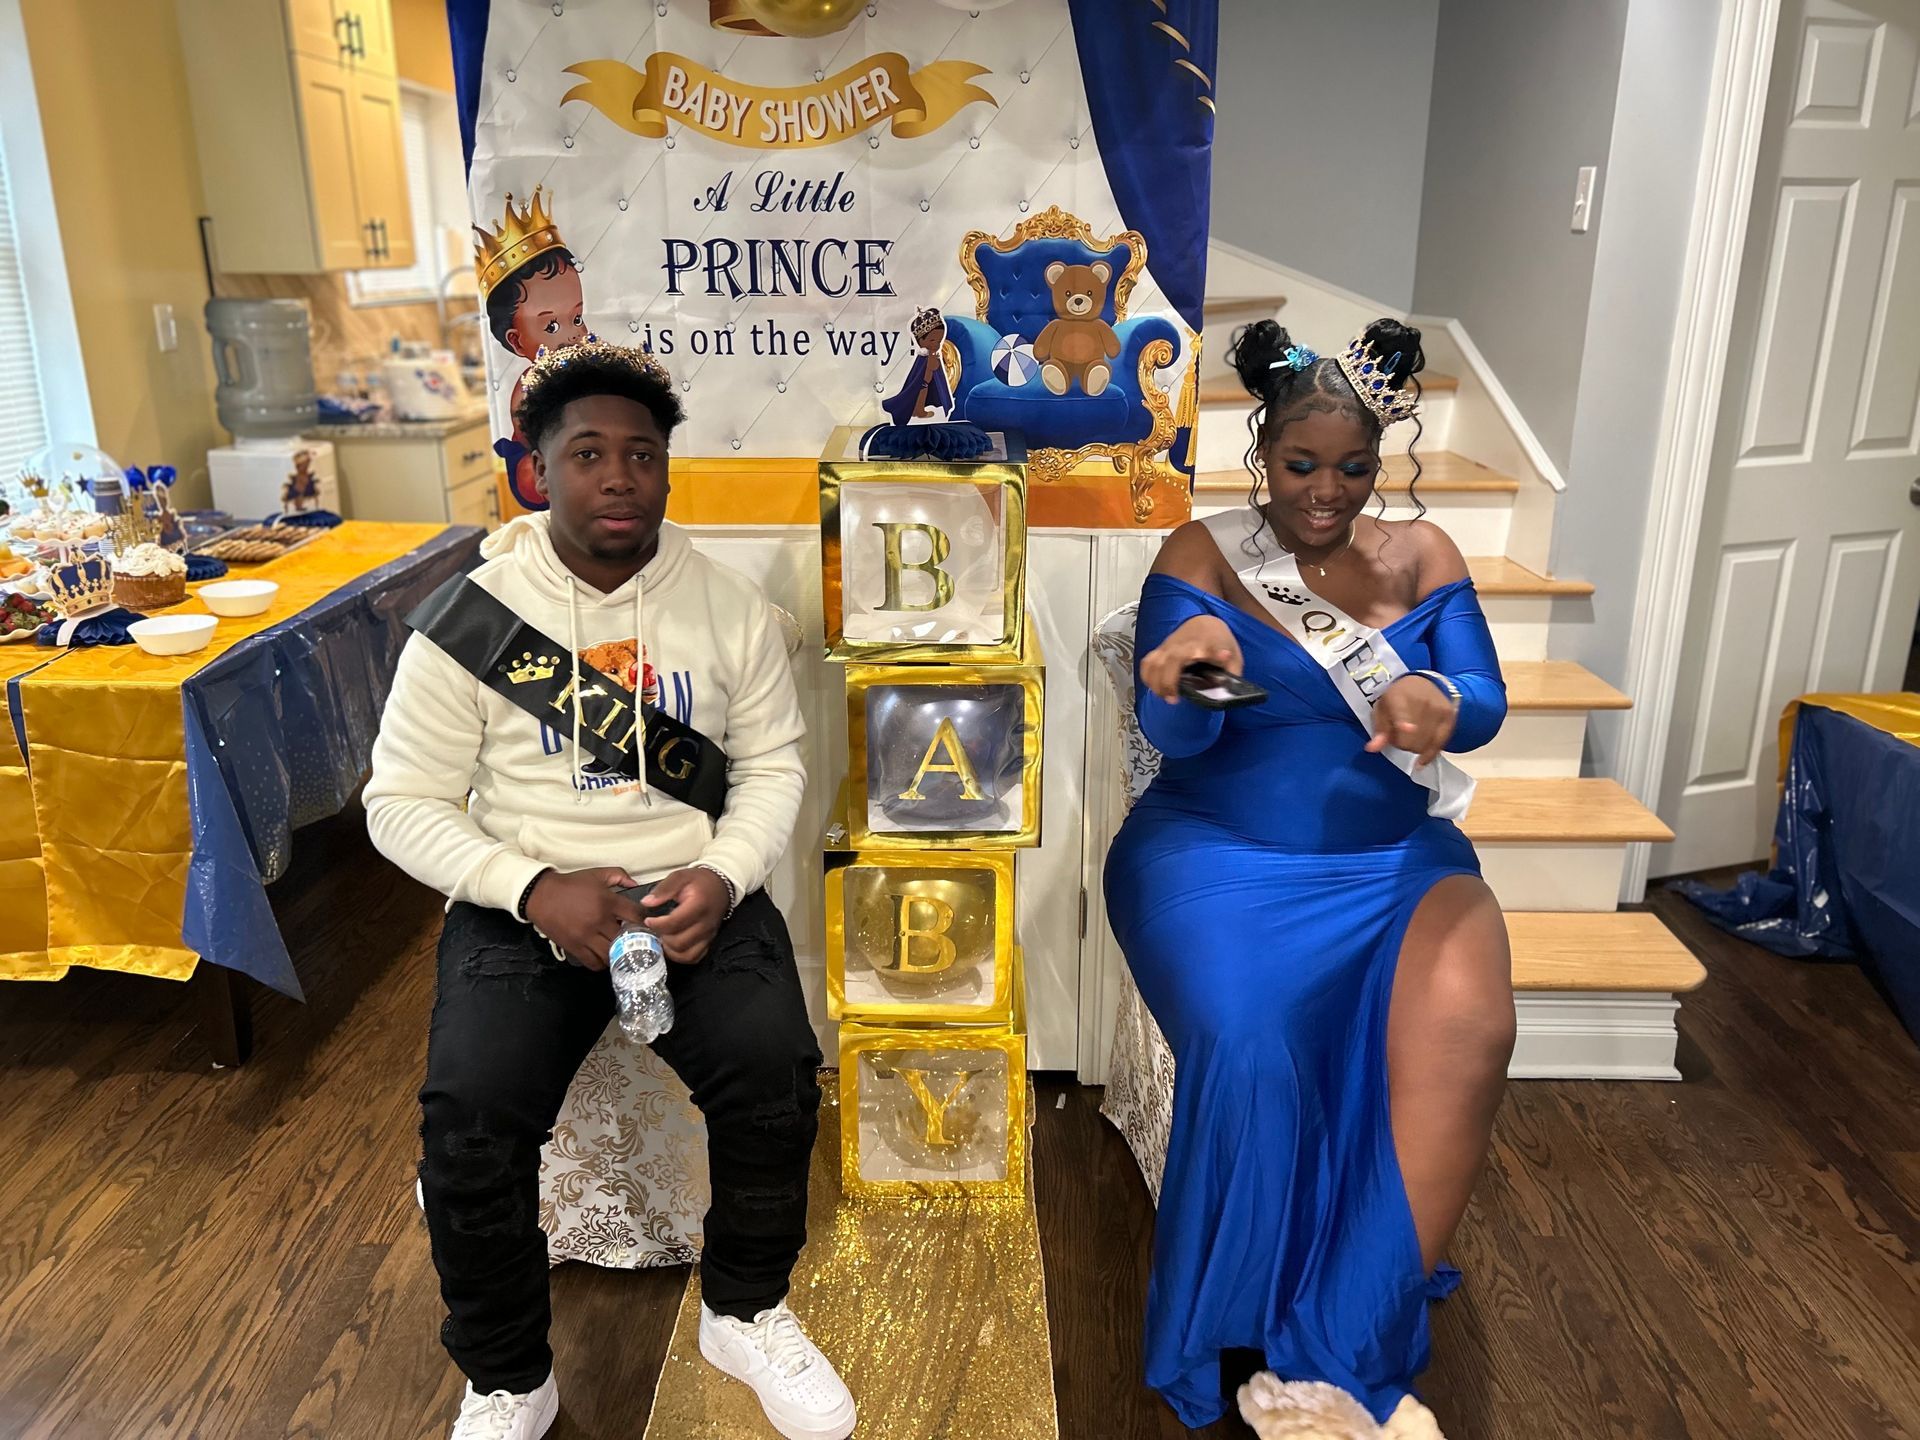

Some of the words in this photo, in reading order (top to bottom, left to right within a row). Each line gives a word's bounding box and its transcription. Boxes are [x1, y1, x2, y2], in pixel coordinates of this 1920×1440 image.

[663, 66, 754, 138] BABY
[760, 67, 901, 144] SHOWER
[693, 170, 734, 212] A
[750, 170, 855, 213] Little
[661, 238, 898, 302] PRINCE
[644, 323, 675, 355] is
[690, 329, 735, 356] on
[750, 319, 810, 356] the
[872, 522, 956, 612] B
[1301, 610, 1393, 709] QUEE
[898, 716, 986, 801] A
[882, 894, 958, 975] B
[890, 1067, 983, 1146] Y
